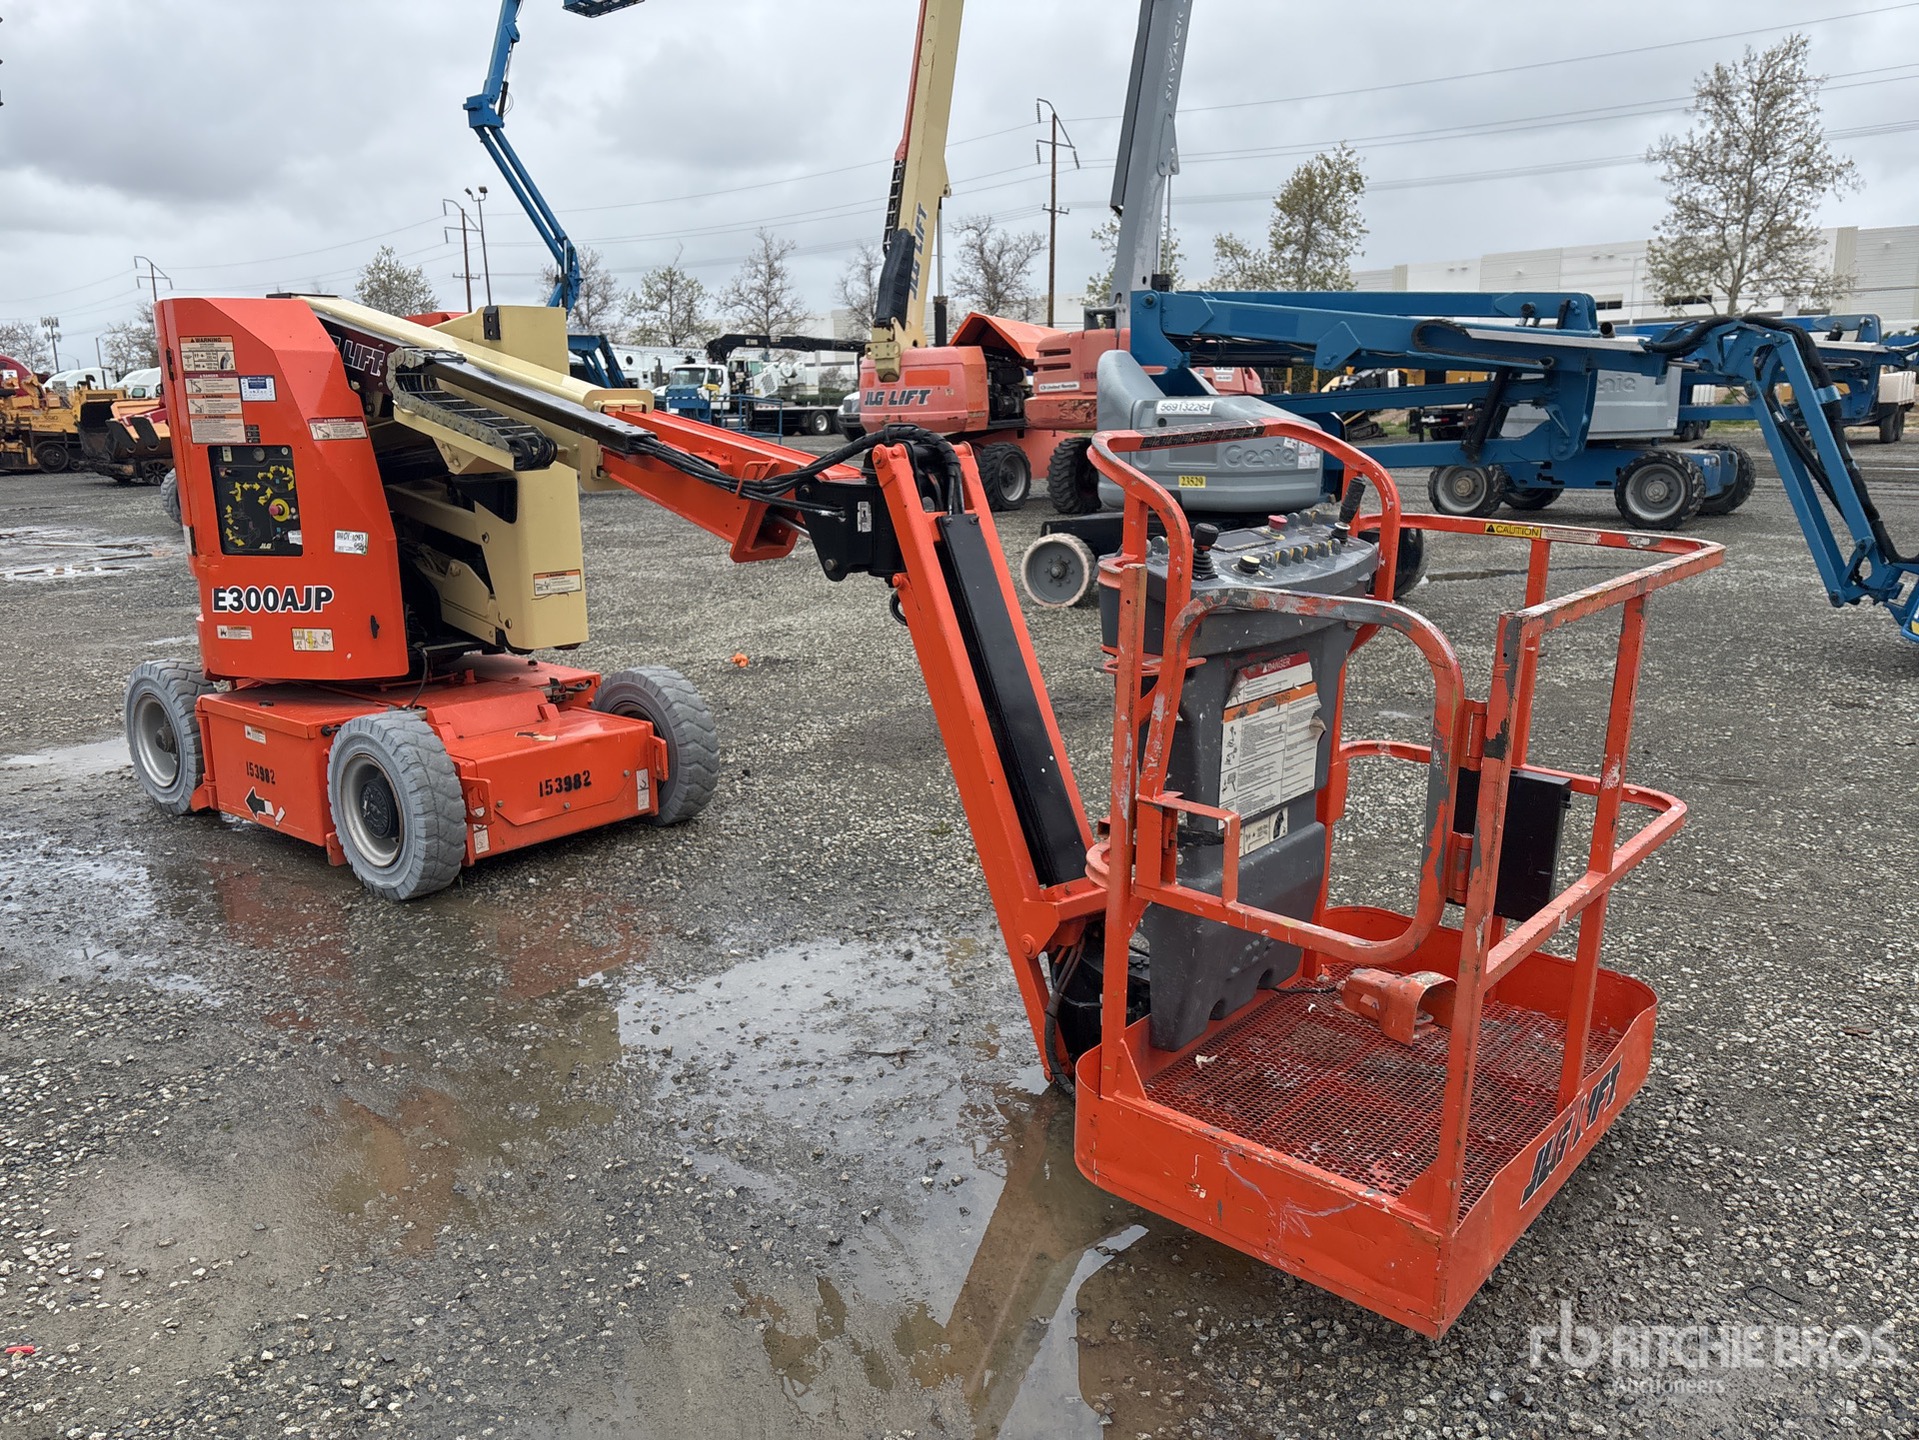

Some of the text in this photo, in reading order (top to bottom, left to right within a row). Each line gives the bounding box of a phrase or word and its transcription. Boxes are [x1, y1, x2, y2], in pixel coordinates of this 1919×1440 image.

[914, 202, 928, 256] LIFT
[342, 338, 386, 377] LIFT
[1597, 374, 1637, 394] nie
[863, 388, 933, 406] JLG LIFT
[1160, 402, 1211, 412] 569132264
[1223, 443, 1296, 469] Genie
[1180, 475, 1205, 487] 23529
[1495, 524, 1539, 537] CAUTION
[212, 585, 335, 613] E300AJP
[1267, 656, 1291, 672] DANGER
[245, 760, 276, 785] 153982
[539, 769, 592, 798] 153982
